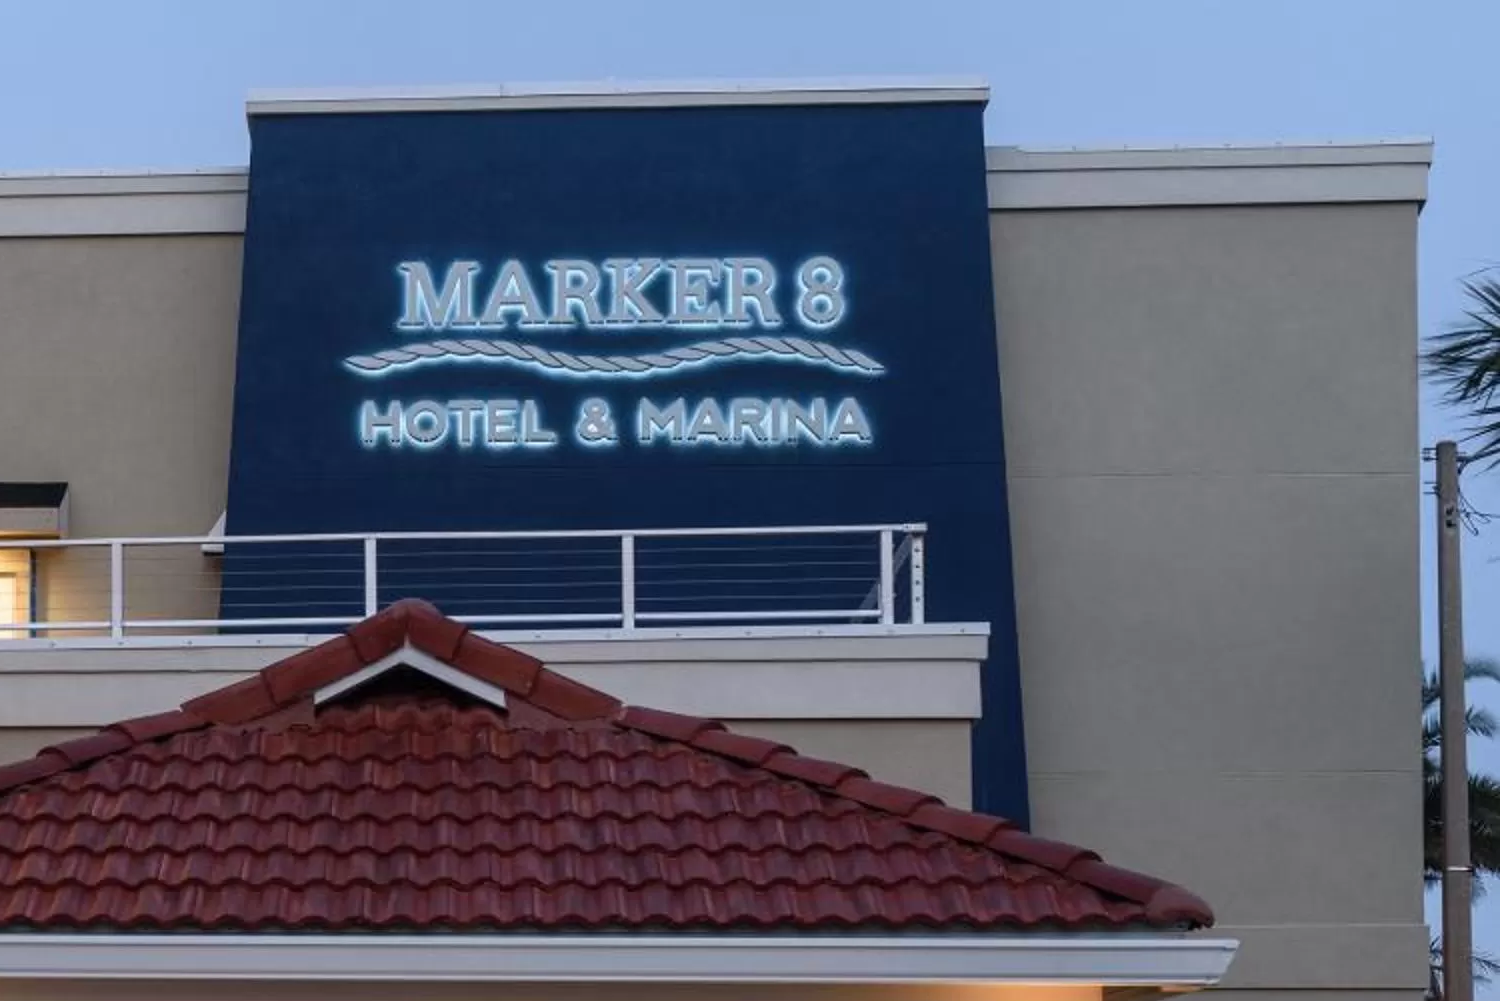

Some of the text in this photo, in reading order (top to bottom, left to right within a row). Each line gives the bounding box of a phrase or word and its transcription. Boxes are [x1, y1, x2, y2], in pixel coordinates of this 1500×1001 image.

[398, 256, 844, 327] MARKER 8
[361, 397, 873, 445] HOTEL & MARINA
